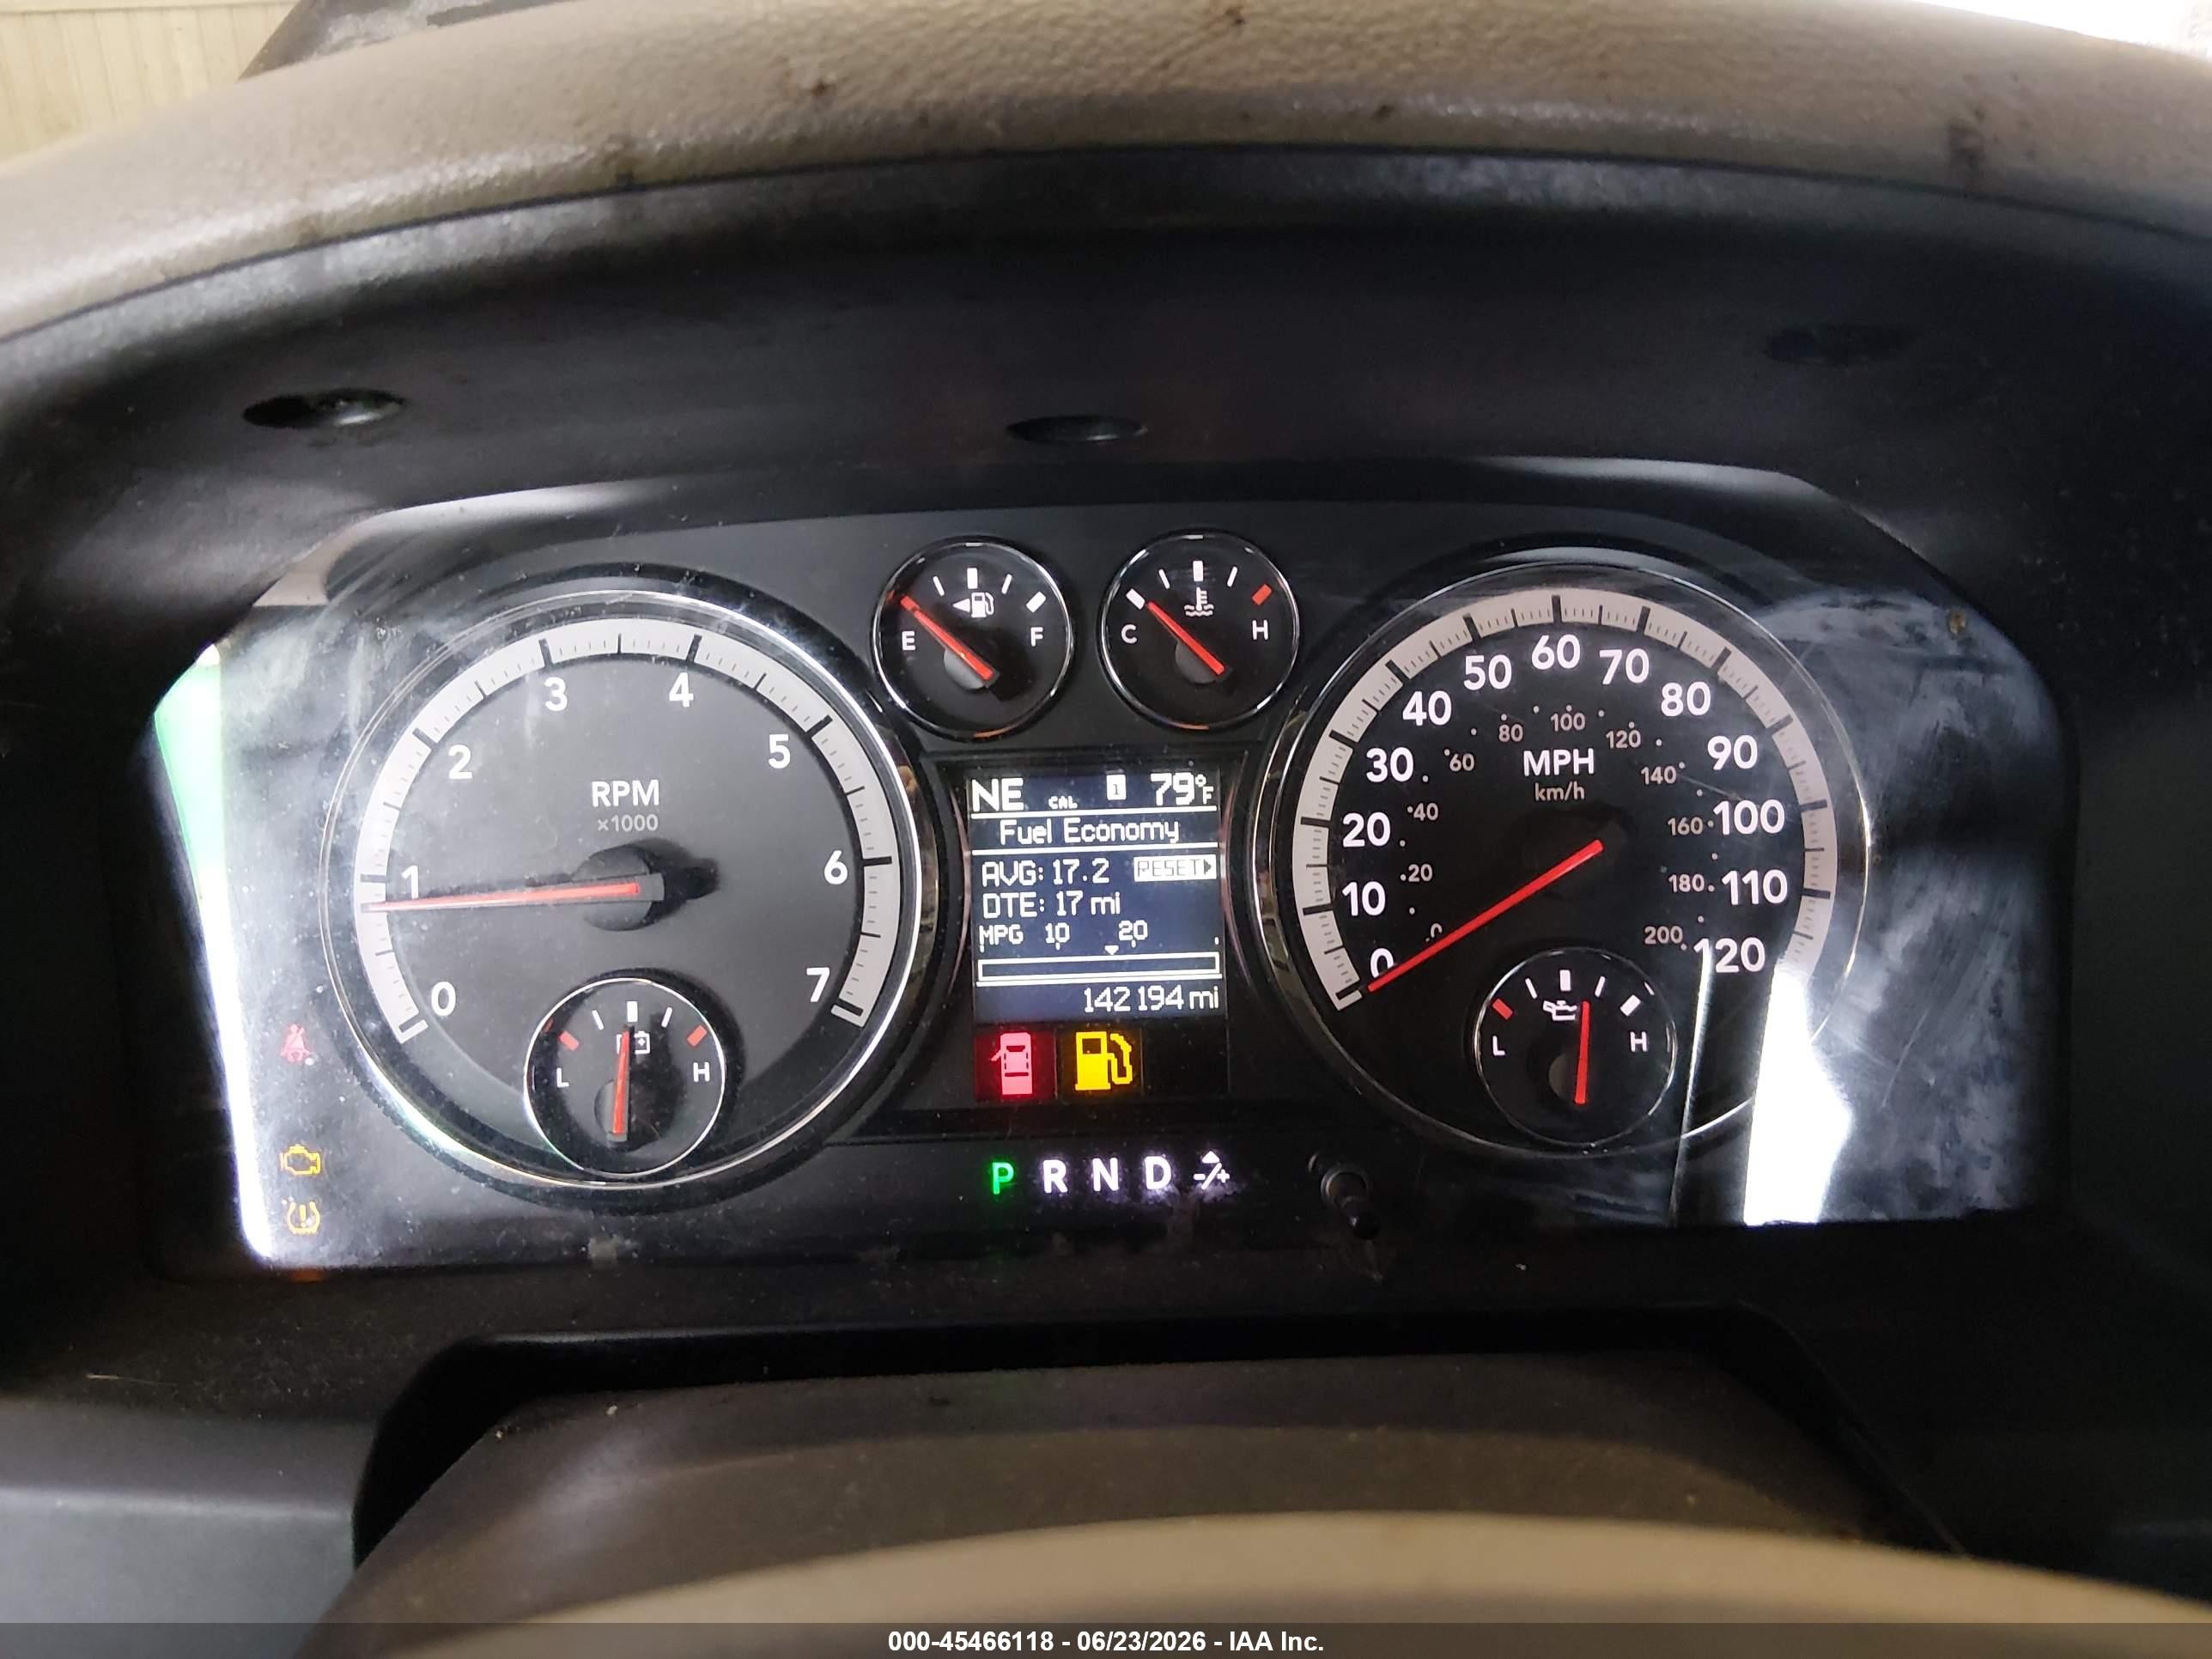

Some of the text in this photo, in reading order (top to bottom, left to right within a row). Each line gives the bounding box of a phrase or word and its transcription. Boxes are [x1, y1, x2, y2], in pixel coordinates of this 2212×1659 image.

[902, 631, 915, 651] E
[1030, 627, 1043, 647] F
[1121, 624, 1137, 644] C
[1252, 620, 1268, 640] H
[1531, 634, 1581, 669] 60
[1463, 655, 1512, 690] 50
[1599, 649, 1650, 684] 70
[544, 678, 568, 711] 3
[668, 673, 694, 708] 4
[1661, 683, 1711, 716] 80
[1402, 691, 1452, 725] 40
[1550, 713, 1586, 731] 100
[1498, 724, 1523, 742] 80
[1606, 730, 1641, 749] 120
[447, 745, 472, 779] 2
[768, 734, 791, 768] 5
[1365, 749, 1413, 781] 30
[1449, 754, 1474, 772] 60
[1523, 749, 1595, 775] MPH
[1706, 735, 1758, 769] 90
[1641, 766, 1677, 785] 140
[591, 780, 659, 806] RPM
[971, 778, 1024, 811] NE
[1048, 795, 1078, 810] CAL
[1534, 781, 1585, 803] km/h
[1413, 803, 1438, 820] 40
[1713, 800, 1784, 834] 100
[1000, 817, 1179, 845] Fuel Economy
[1342, 813, 1391, 847] 20
[1668, 817, 1703, 836] 160
[823, 849, 848, 884] 6
[981, 858, 1109, 886] AVG: 17.2
[1137, 860, 1199, 878] RESET
[1407, 865, 1432, 881] 20
[402, 866, 419, 899] 1
[1668, 874, 1705, 892] 180
[1722, 871, 1788, 905] 110
[982, 890, 1121, 919] DTE: 17 mi
[1343, 882, 1385, 915] 10
[979, 920, 1148, 945] MPG 10 20
[1644, 926, 1683, 945] 200
[1370, 948, 1395, 976] 0
[1693, 938, 1765, 973] 120
[806, 967, 830, 1001] 7
[1189, 987, 1218, 1009] mi
[431, 981, 456, 1016] 0
[1492, 1036, 1505, 1055] L
[1630, 1032, 1648, 1052] H
[556, 1067, 569, 1087] L
[693, 1062, 710, 1082] H
[993, 1156, 1171, 1194] P R N D
